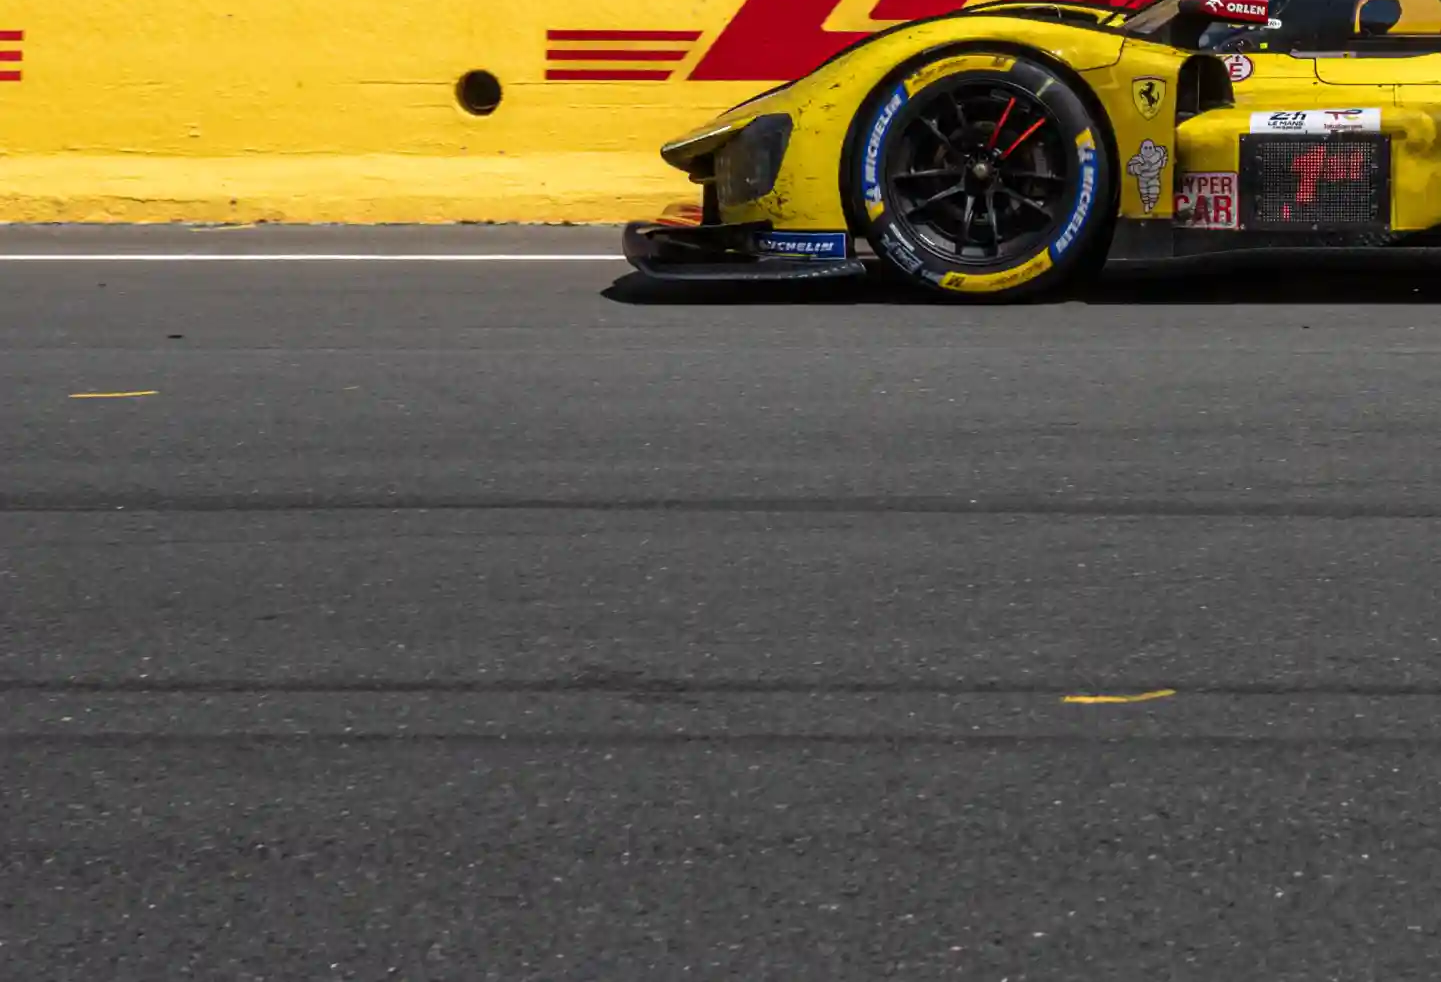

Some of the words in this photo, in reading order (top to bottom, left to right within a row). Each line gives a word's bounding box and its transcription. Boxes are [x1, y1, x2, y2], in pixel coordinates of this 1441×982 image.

[1226, 2, 1266, 16] ORLEN
[865, 94, 902, 183] MICHELIN
[1055, 166, 1095, 254] MICHELIN
[1175, 194, 1232, 223] CAR
